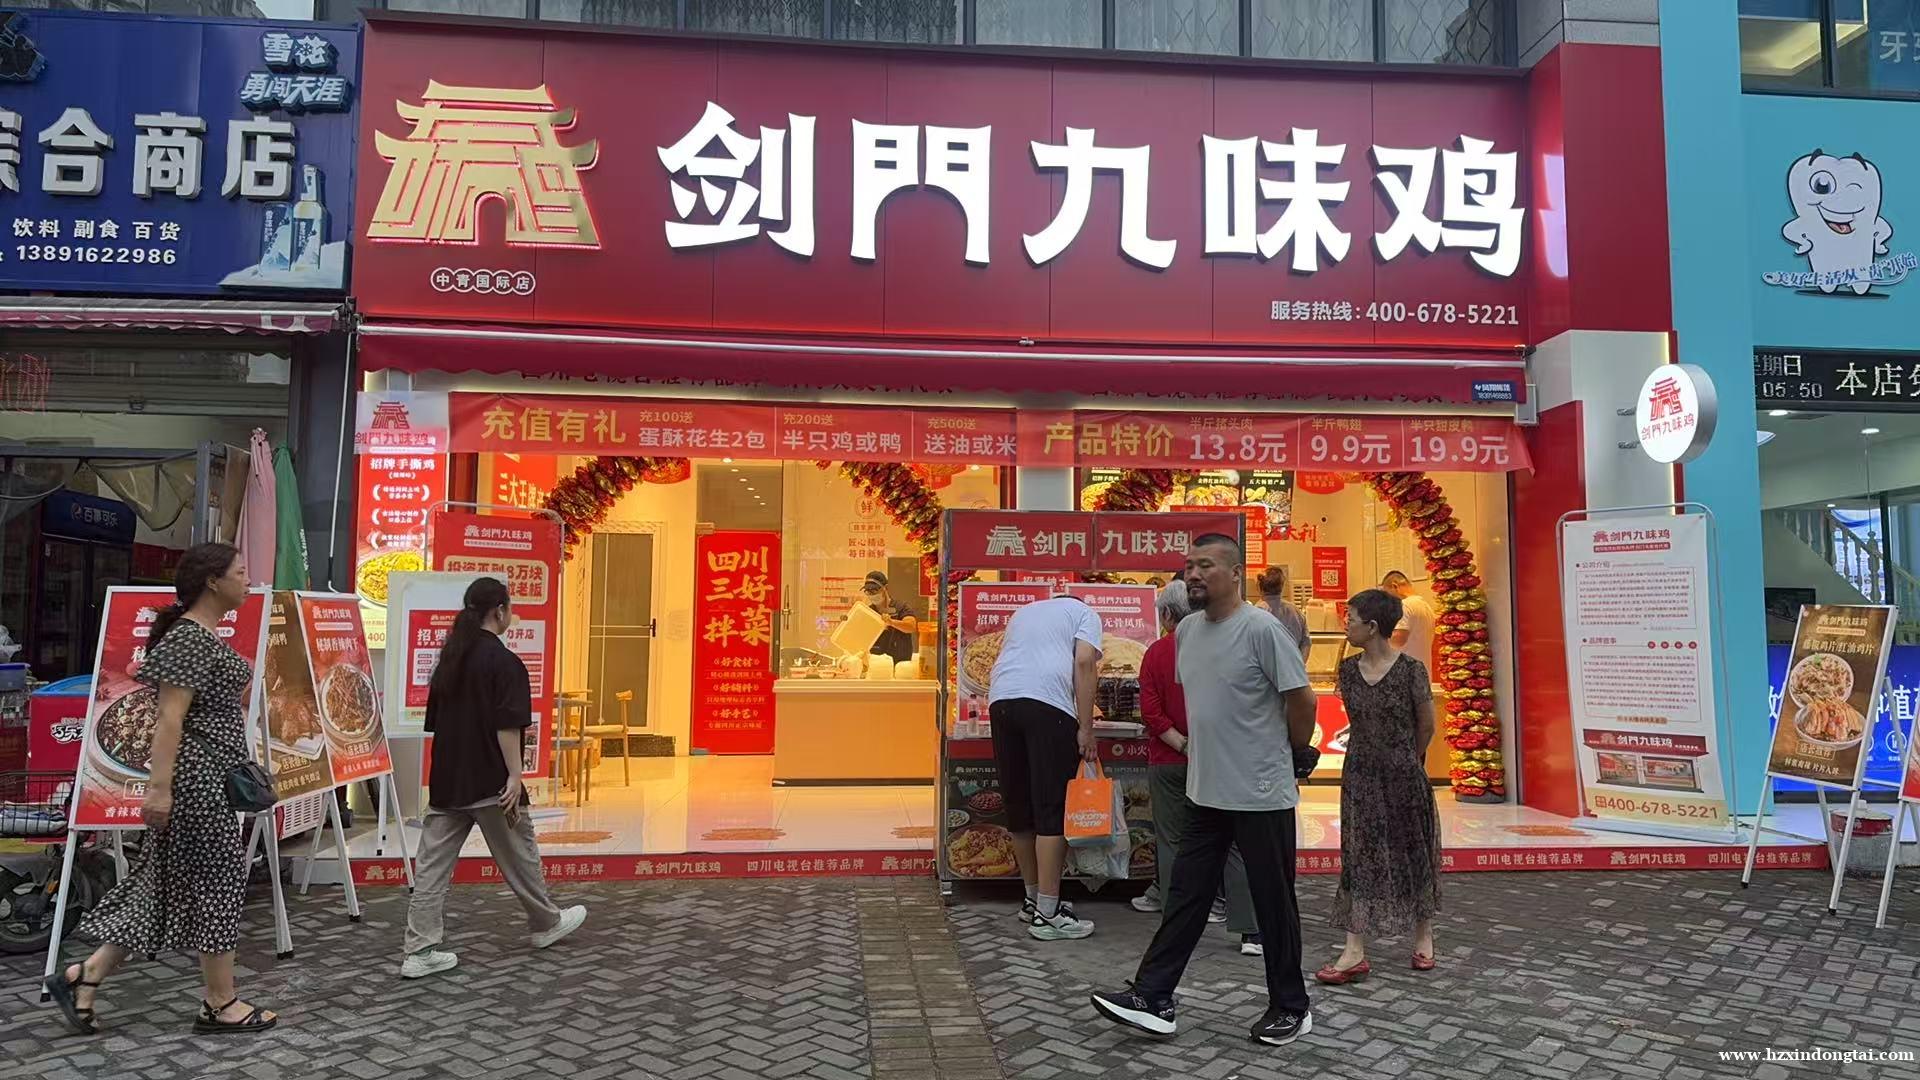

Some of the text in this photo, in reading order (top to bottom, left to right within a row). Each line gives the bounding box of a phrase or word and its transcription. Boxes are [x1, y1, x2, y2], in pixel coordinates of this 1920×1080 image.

[262, 33, 328, 65] 雪花
[1880, 31, 1920, 63] 牙
[241, 73, 346, 104] 勇闯天涯
[657, 101, 1526, 277] 剑門九味鸡
[13, 218, 180, 241] 饮料 副食 百货
[16, 245, 177, 265] 13891622986
[434, 271, 534, 292] 中青国际店
[481, 406, 626, 443] 充值有礼
[640, 411, 694, 424] 充100送
[784, 413, 833, 425] 充200送
[928, 417, 976, 430] 充500送
[1190, 416, 1253, 431] 半斤猪头肉
[638, 427, 765, 449] 蛋酥花生2包
[782, 430, 901, 454] 半只鸡或鸭
[924, 433, 1017, 455] 送油或米
[1044, 422, 1174, 457] 产品特价
[1190, 433, 1287, 464] 13.8元
[1311, 434, 1391, 464] 9.9元
[1411, 435, 1509, 465] 19.9元
[1032, 530, 1190, 556] 剑門 九味鸡
[707, 546, 769, 573] 四川
[705, 574, 774, 602] 三好
[703, 603, 773, 648] 拌菜
[1067, 811, 1108, 822] Welcome
[1607, 797, 1718, 821] 400-678-5221
[656, 861, 721, 874] 剑門九味鸡
[747, 858, 865, 873] 四川电视台推荐品牌
[1477, 853, 1584, 866] 四川电视台推荐品牌
